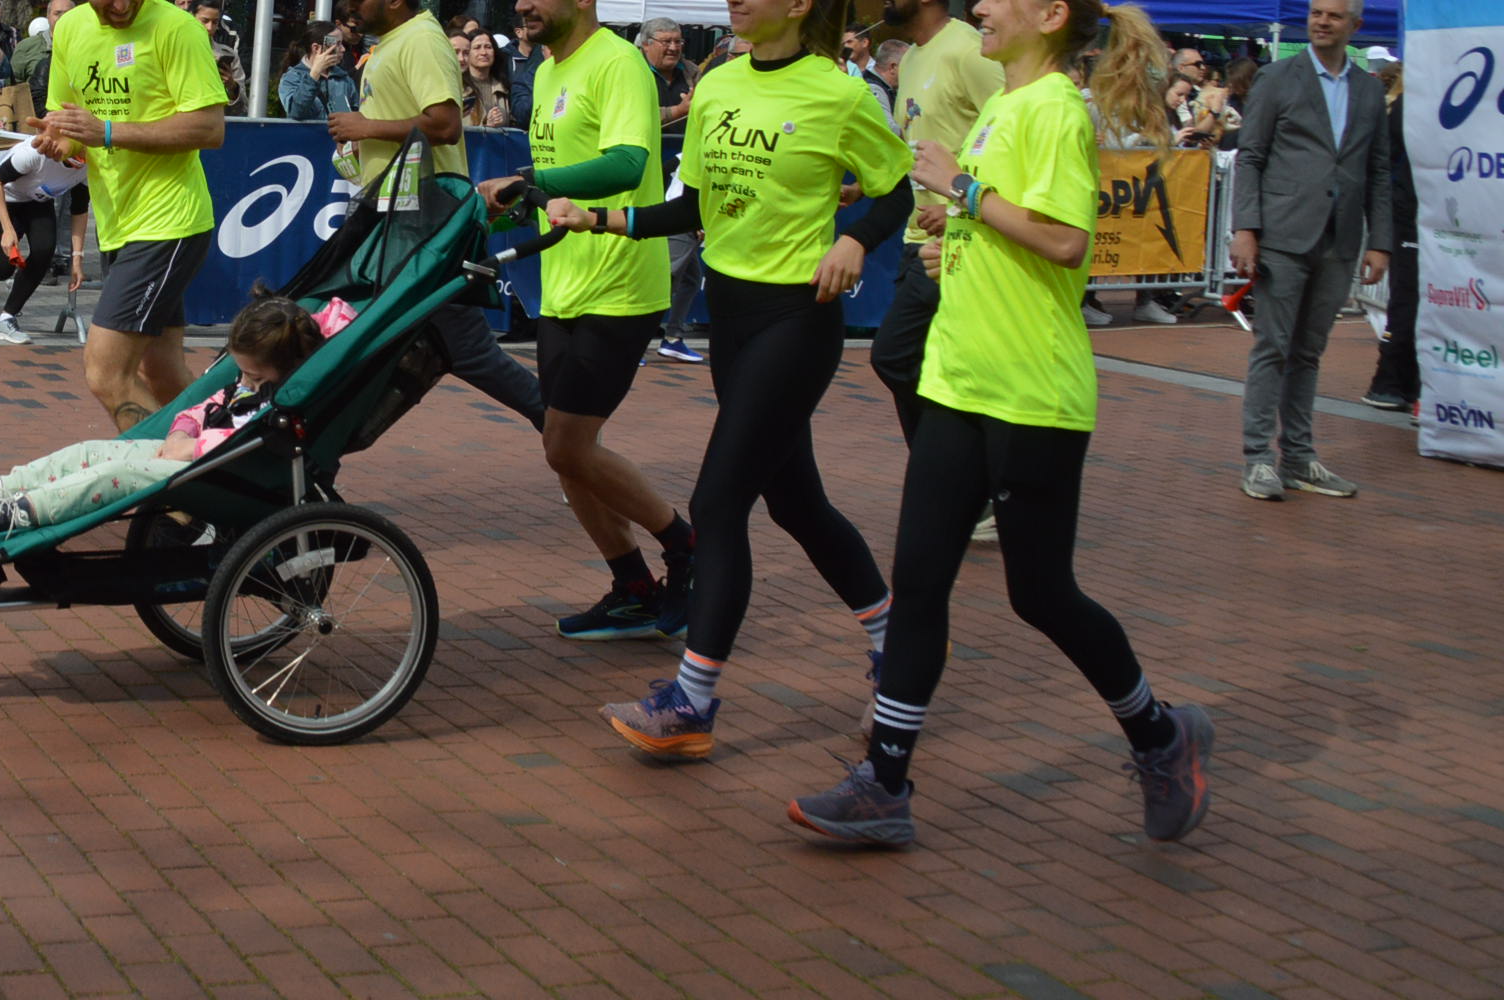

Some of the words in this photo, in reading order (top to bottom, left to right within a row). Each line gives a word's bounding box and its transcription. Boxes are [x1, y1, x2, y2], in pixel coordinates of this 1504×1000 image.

[704, 150, 728, 160] with
[731, 151, 773, 167] those
[705, 164, 728, 174] who
[731, 165, 765, 180] can't
[1435, 402, 1495, 430] DEVIN
